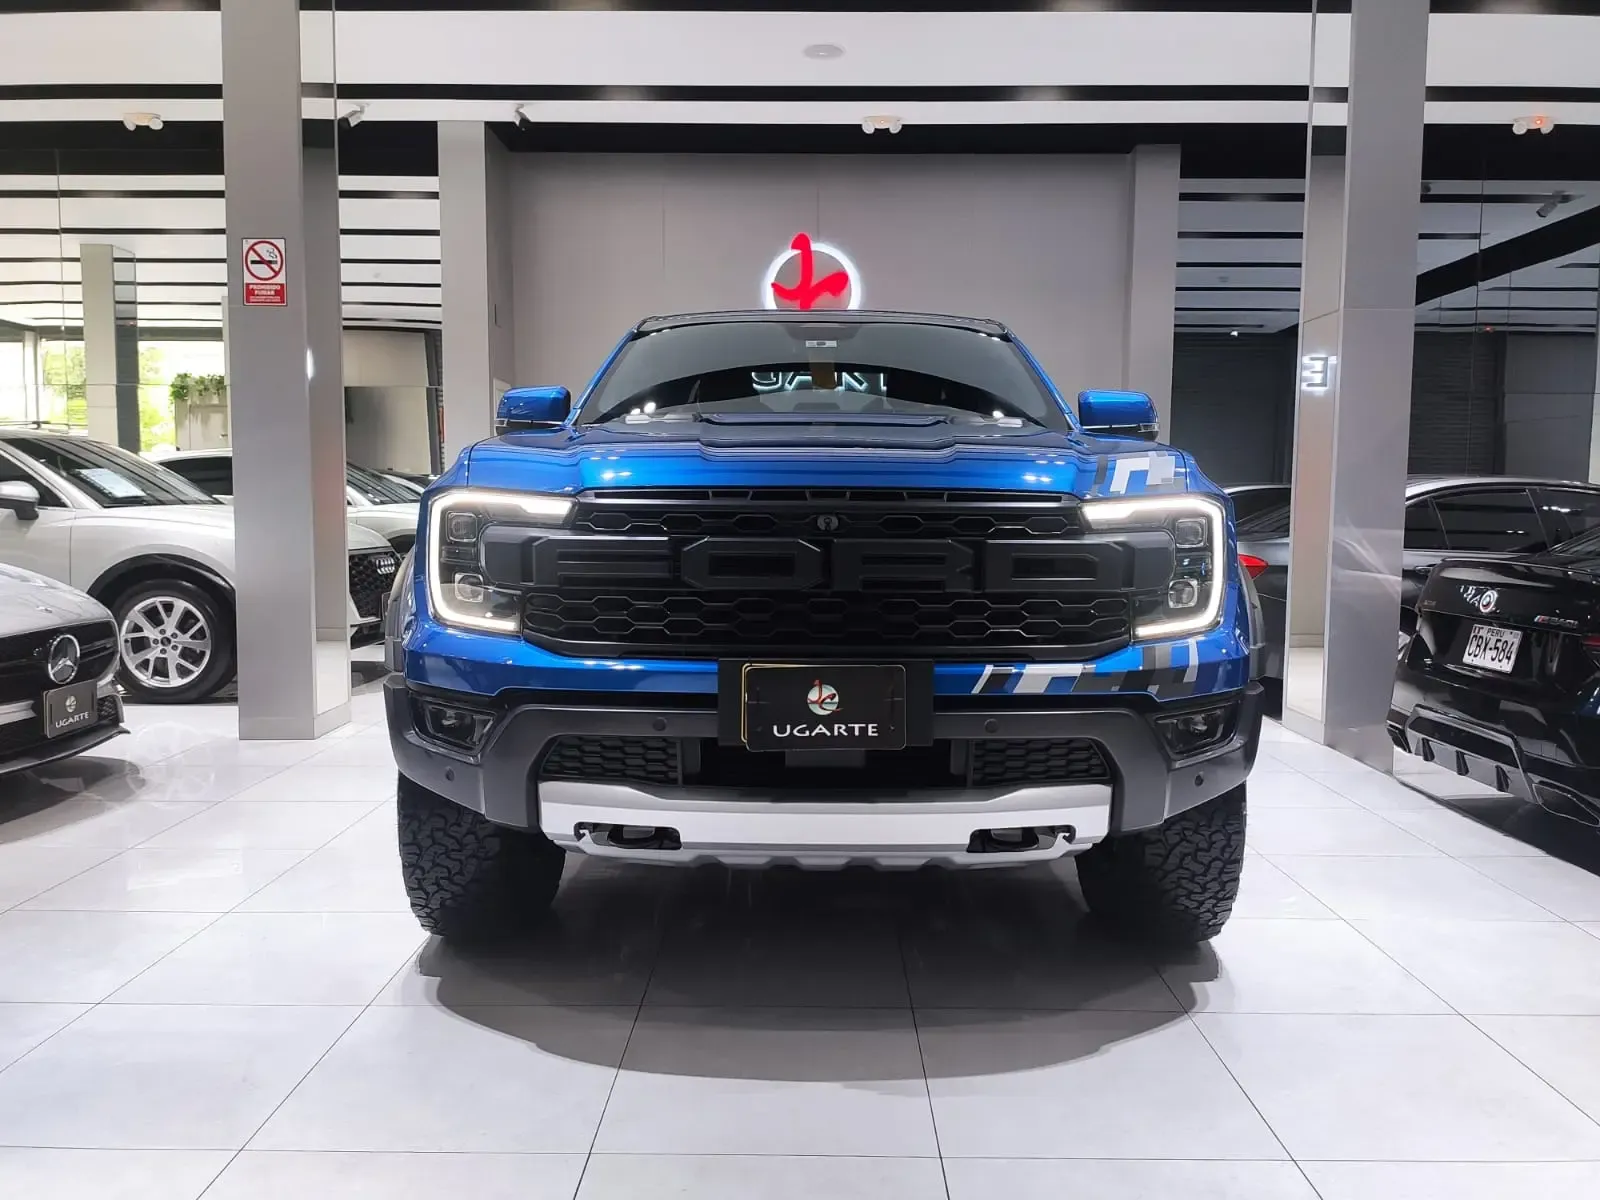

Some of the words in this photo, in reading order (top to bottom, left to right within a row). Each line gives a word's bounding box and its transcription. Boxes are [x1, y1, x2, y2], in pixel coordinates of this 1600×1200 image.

[1467, 634, 1514, 664] CBX-584
[55, 711, 89, 728] UGARTE
[772, 723, 879, 737] UGARTE
